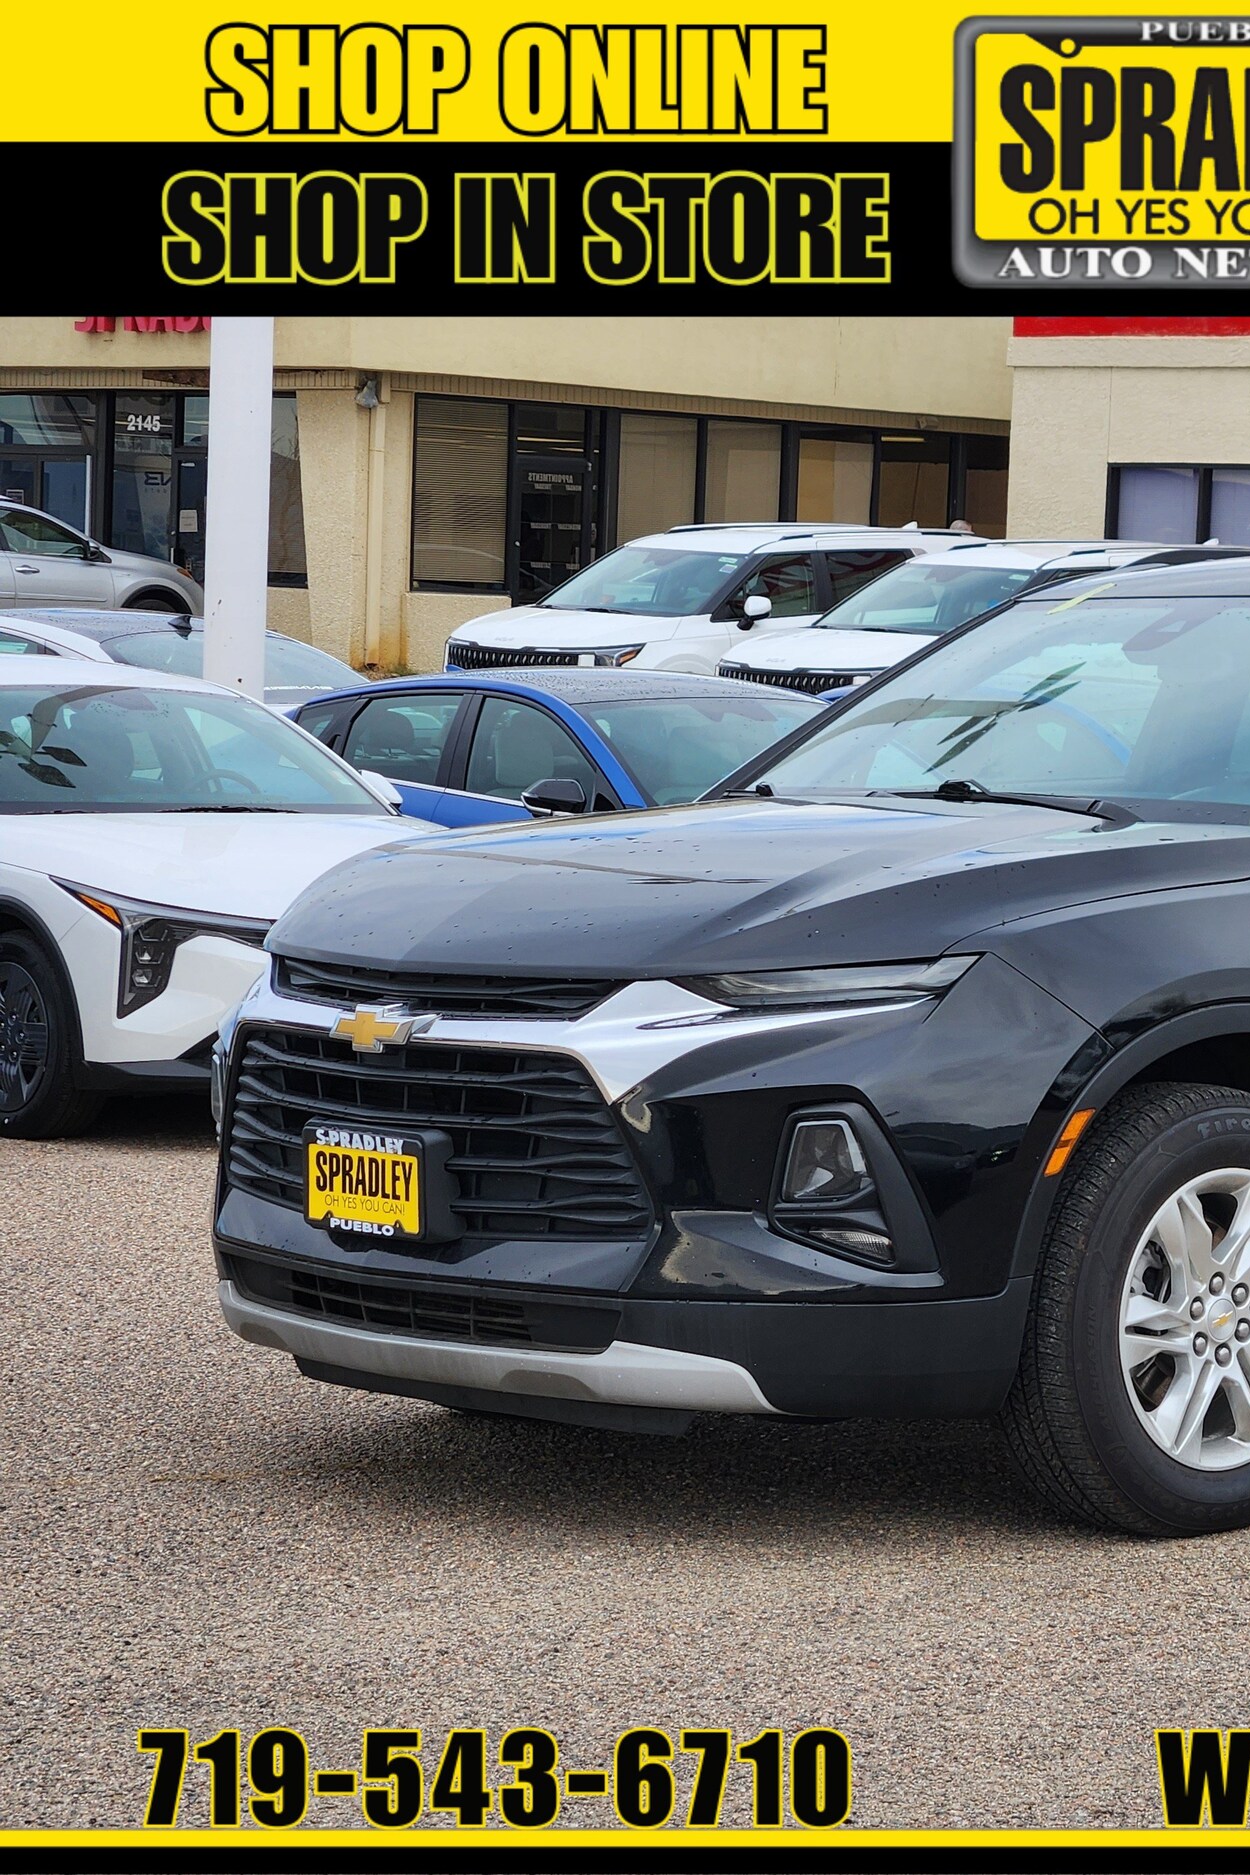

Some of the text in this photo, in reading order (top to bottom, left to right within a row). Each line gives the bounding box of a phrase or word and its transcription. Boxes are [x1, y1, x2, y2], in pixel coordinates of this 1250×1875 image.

[126, 414, 161, 432] 2145
[315, 1128, 404, 1156] SPRADLEY
[315, 1150, 413, 1202] SPRADLEY
[324, 1194, 406, 1216] OH YES YOU CAN!
[329, 1217, 395, 1237] PUEBLO
